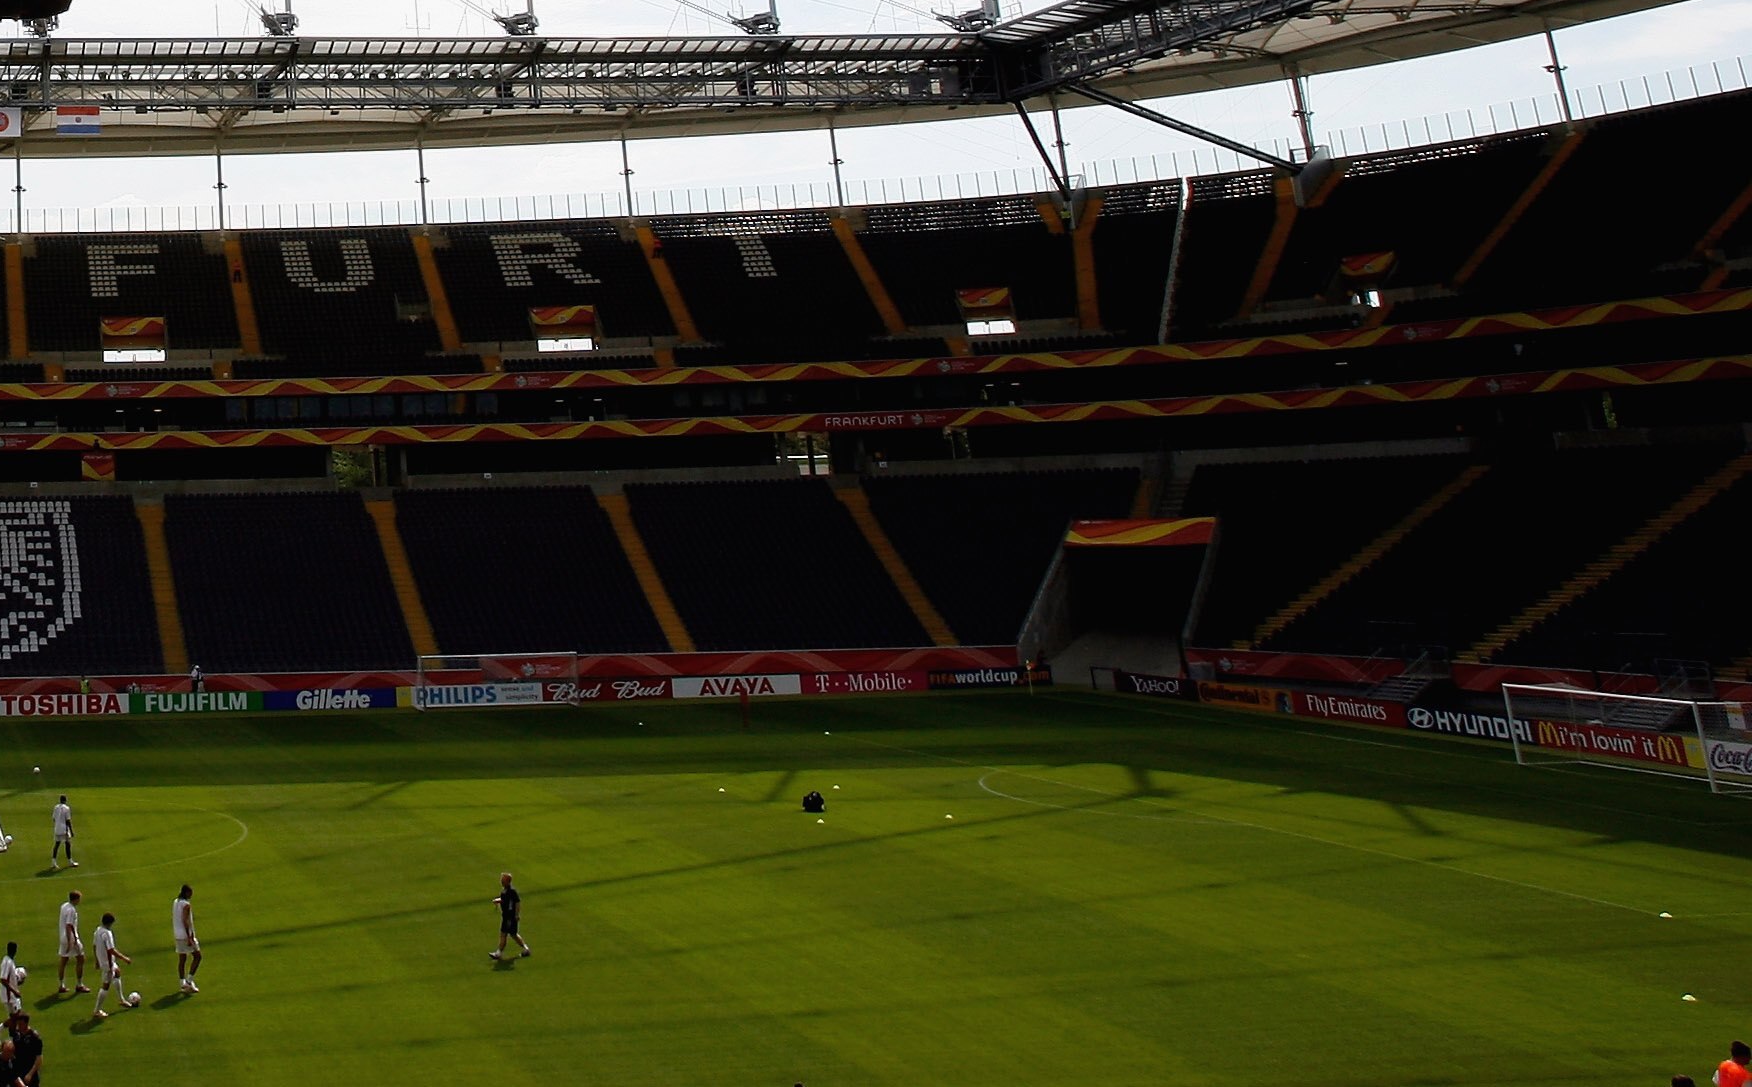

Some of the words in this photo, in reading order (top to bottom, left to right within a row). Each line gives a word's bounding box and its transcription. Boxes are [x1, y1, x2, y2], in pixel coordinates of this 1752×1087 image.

[824, 414, 904, 428] FRANKFURT
[416, 686, 498, 705] PHILIPS
[547, 680, 601, 702] Bud
[611, 680, 667, 699] Bud
[700, 676, 775, 696] AVAYA
[1, 694, 122, 716] TOSHIBA
[145, 692, 247, 712] FUJIFILM
[296, 689, 371, 710] Gillette
[1305, 693, 1329, 718] Fly
[1330, 697, 1387, 721] Emirates
[1435, 710, 1533, 744] HYUNDAI
[1642, 736, 1658, 758] it
